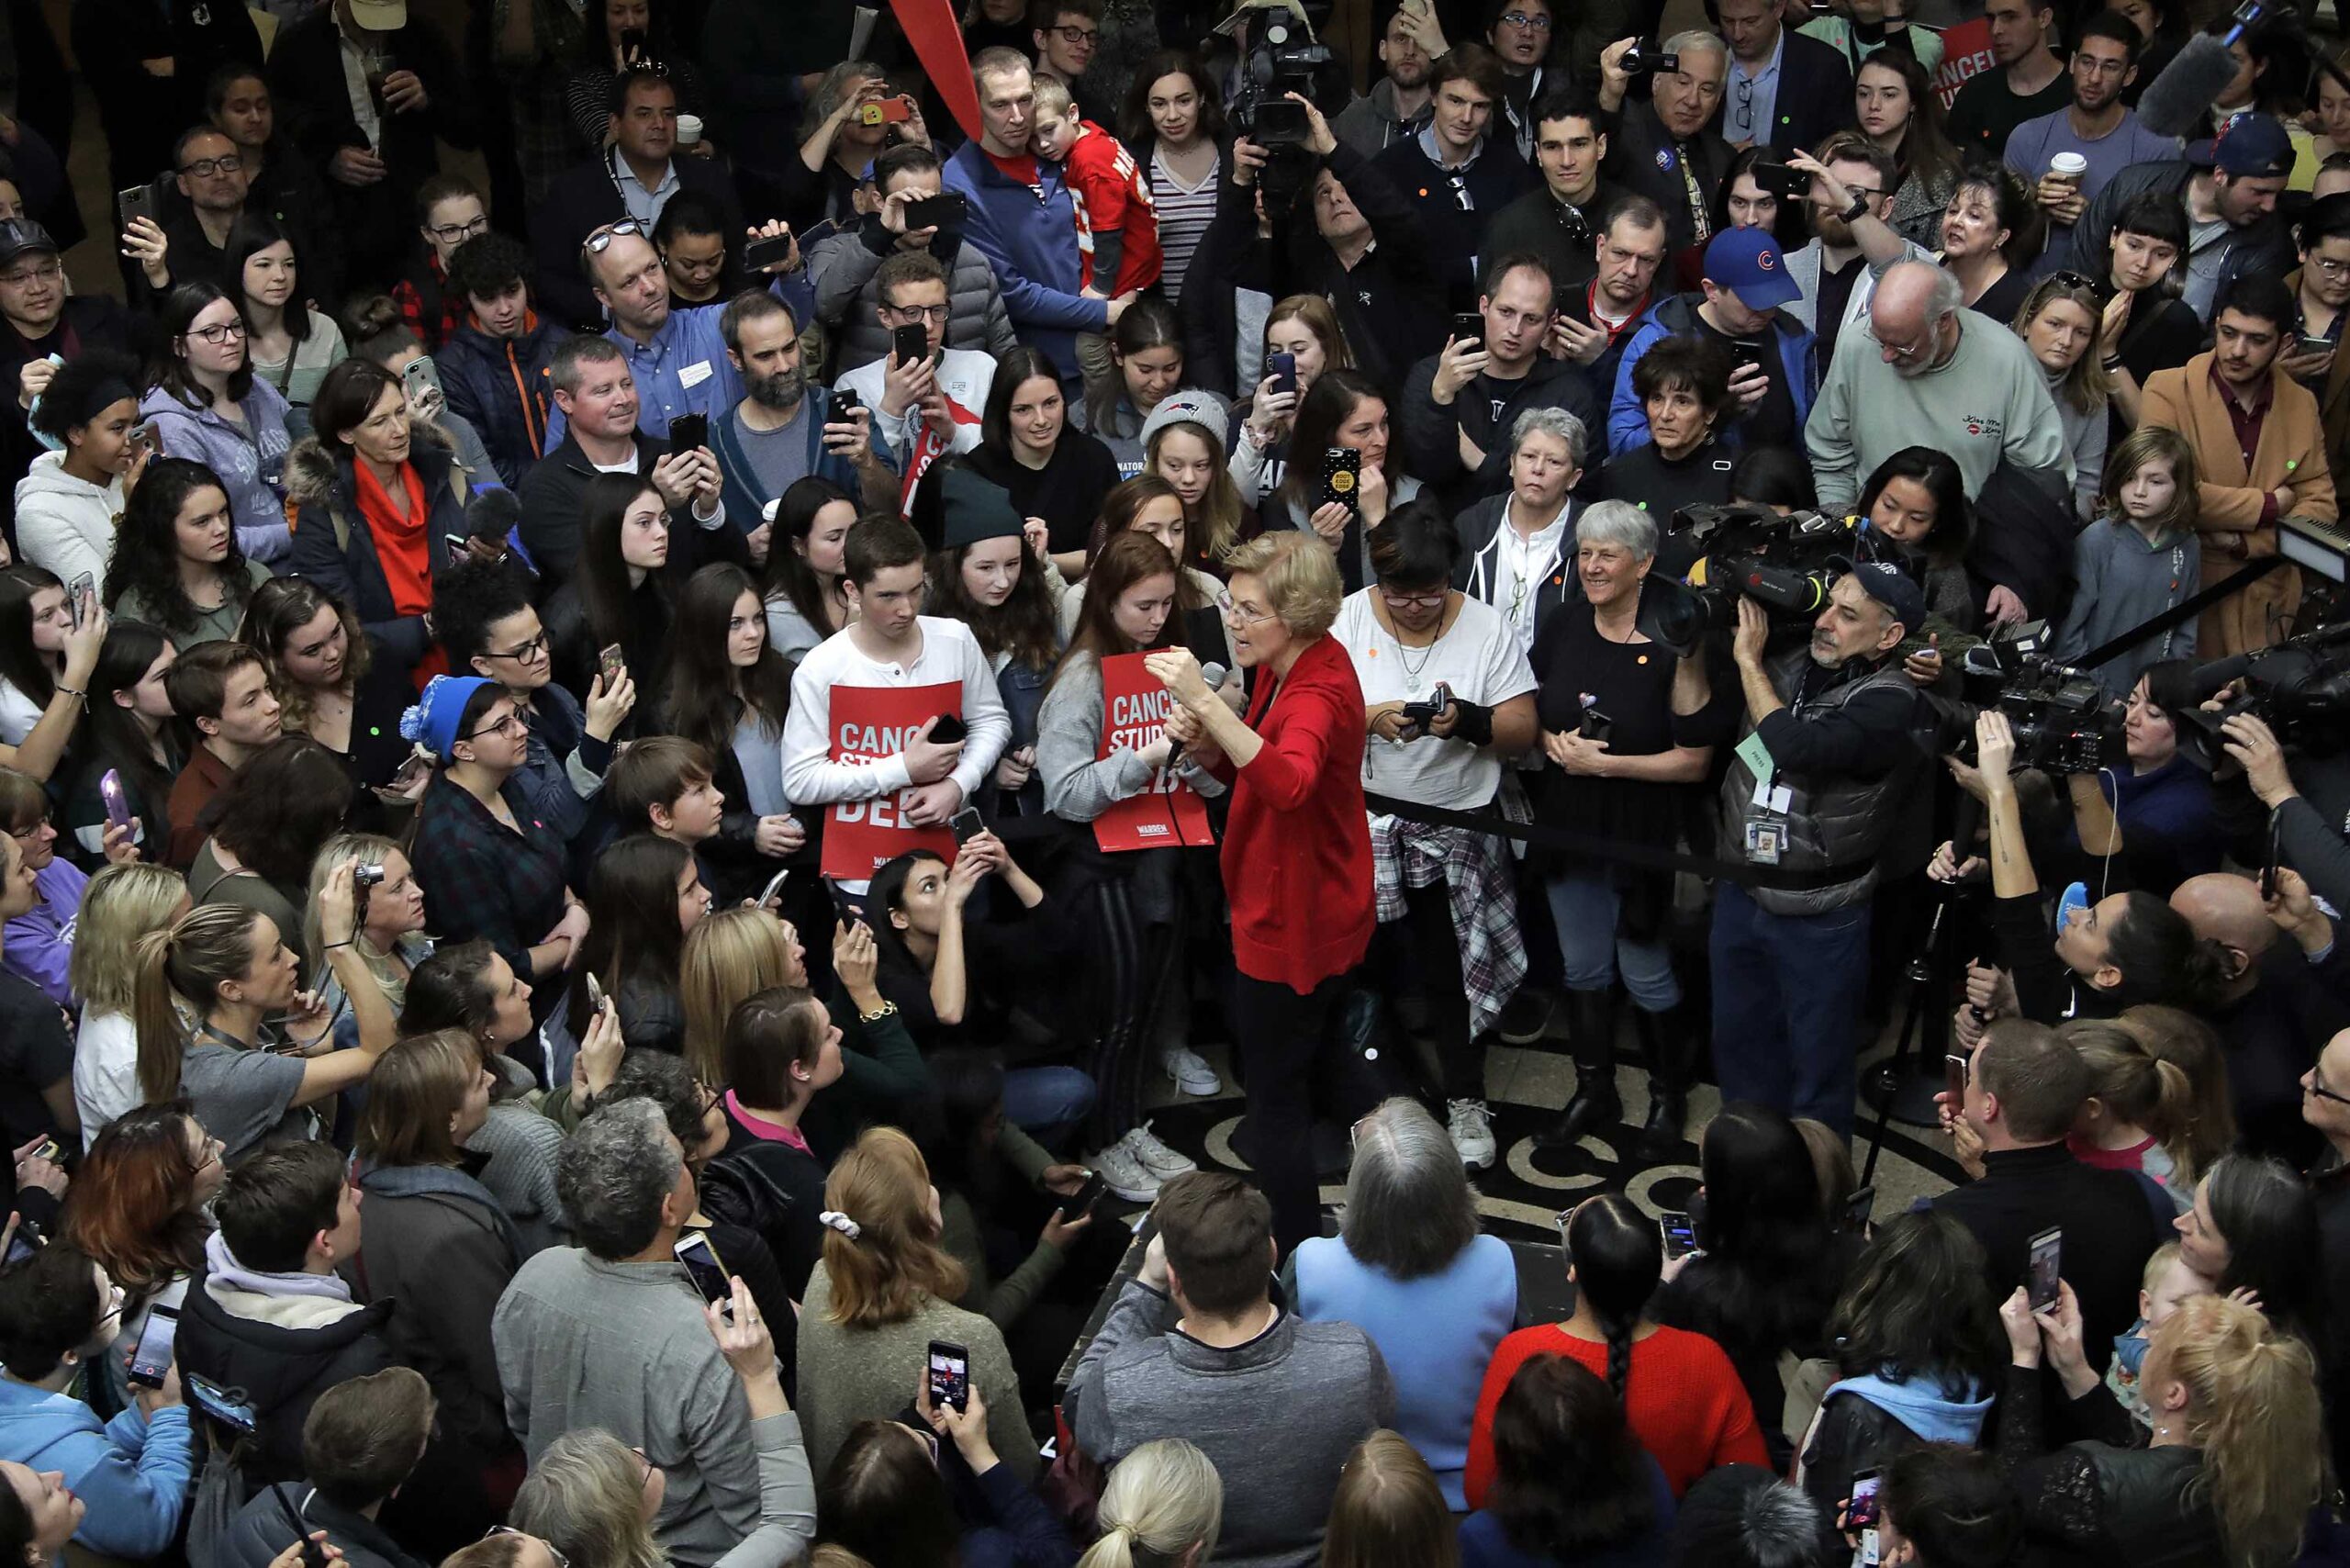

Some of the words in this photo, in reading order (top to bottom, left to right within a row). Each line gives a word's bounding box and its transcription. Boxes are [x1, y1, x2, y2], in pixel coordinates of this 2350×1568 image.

[1930, 49, 1996, 92] ANCE
[1757, 250, 1774, 272] C
[1113, 689, 1179, 726] CANC
[840, 722, 923, 755] CANC
[1108, 724, 1165, 754] STUD
[873, 856, 896, 867] WAR
